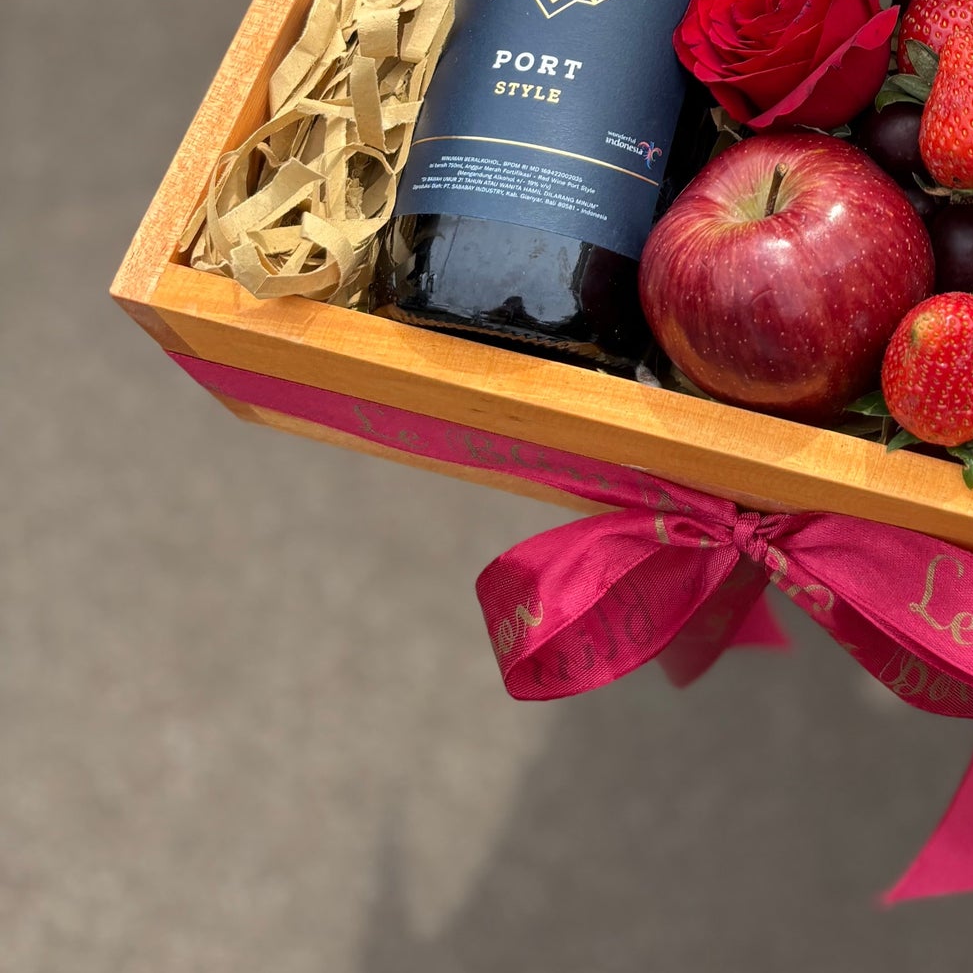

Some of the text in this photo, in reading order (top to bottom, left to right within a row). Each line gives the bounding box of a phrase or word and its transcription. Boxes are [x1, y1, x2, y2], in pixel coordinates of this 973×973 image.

[492, 49, 583, 80] PORT
[494, 80, 561, 103] STYLE
[607, 130, 637, 144] wonderful
[503, 161, 520, 169] BPOM
[530, 165, 540, 173] MD
[493, 174, 515, 183] Alkohol
[538, 174, 550, 182] Red
[551, 177, 566, 186] Wine
[567, 181, 580, 190] Port
[580, 184, 596, 194] Style
[464, 177, 484, 185] TAHUN
[499, 182, 522, 191] WANITA
[543, 190, 575, 203] DILARANG
[545, 198, 557, 206] Bali
[580, 208, 608, 221] Indonesia
